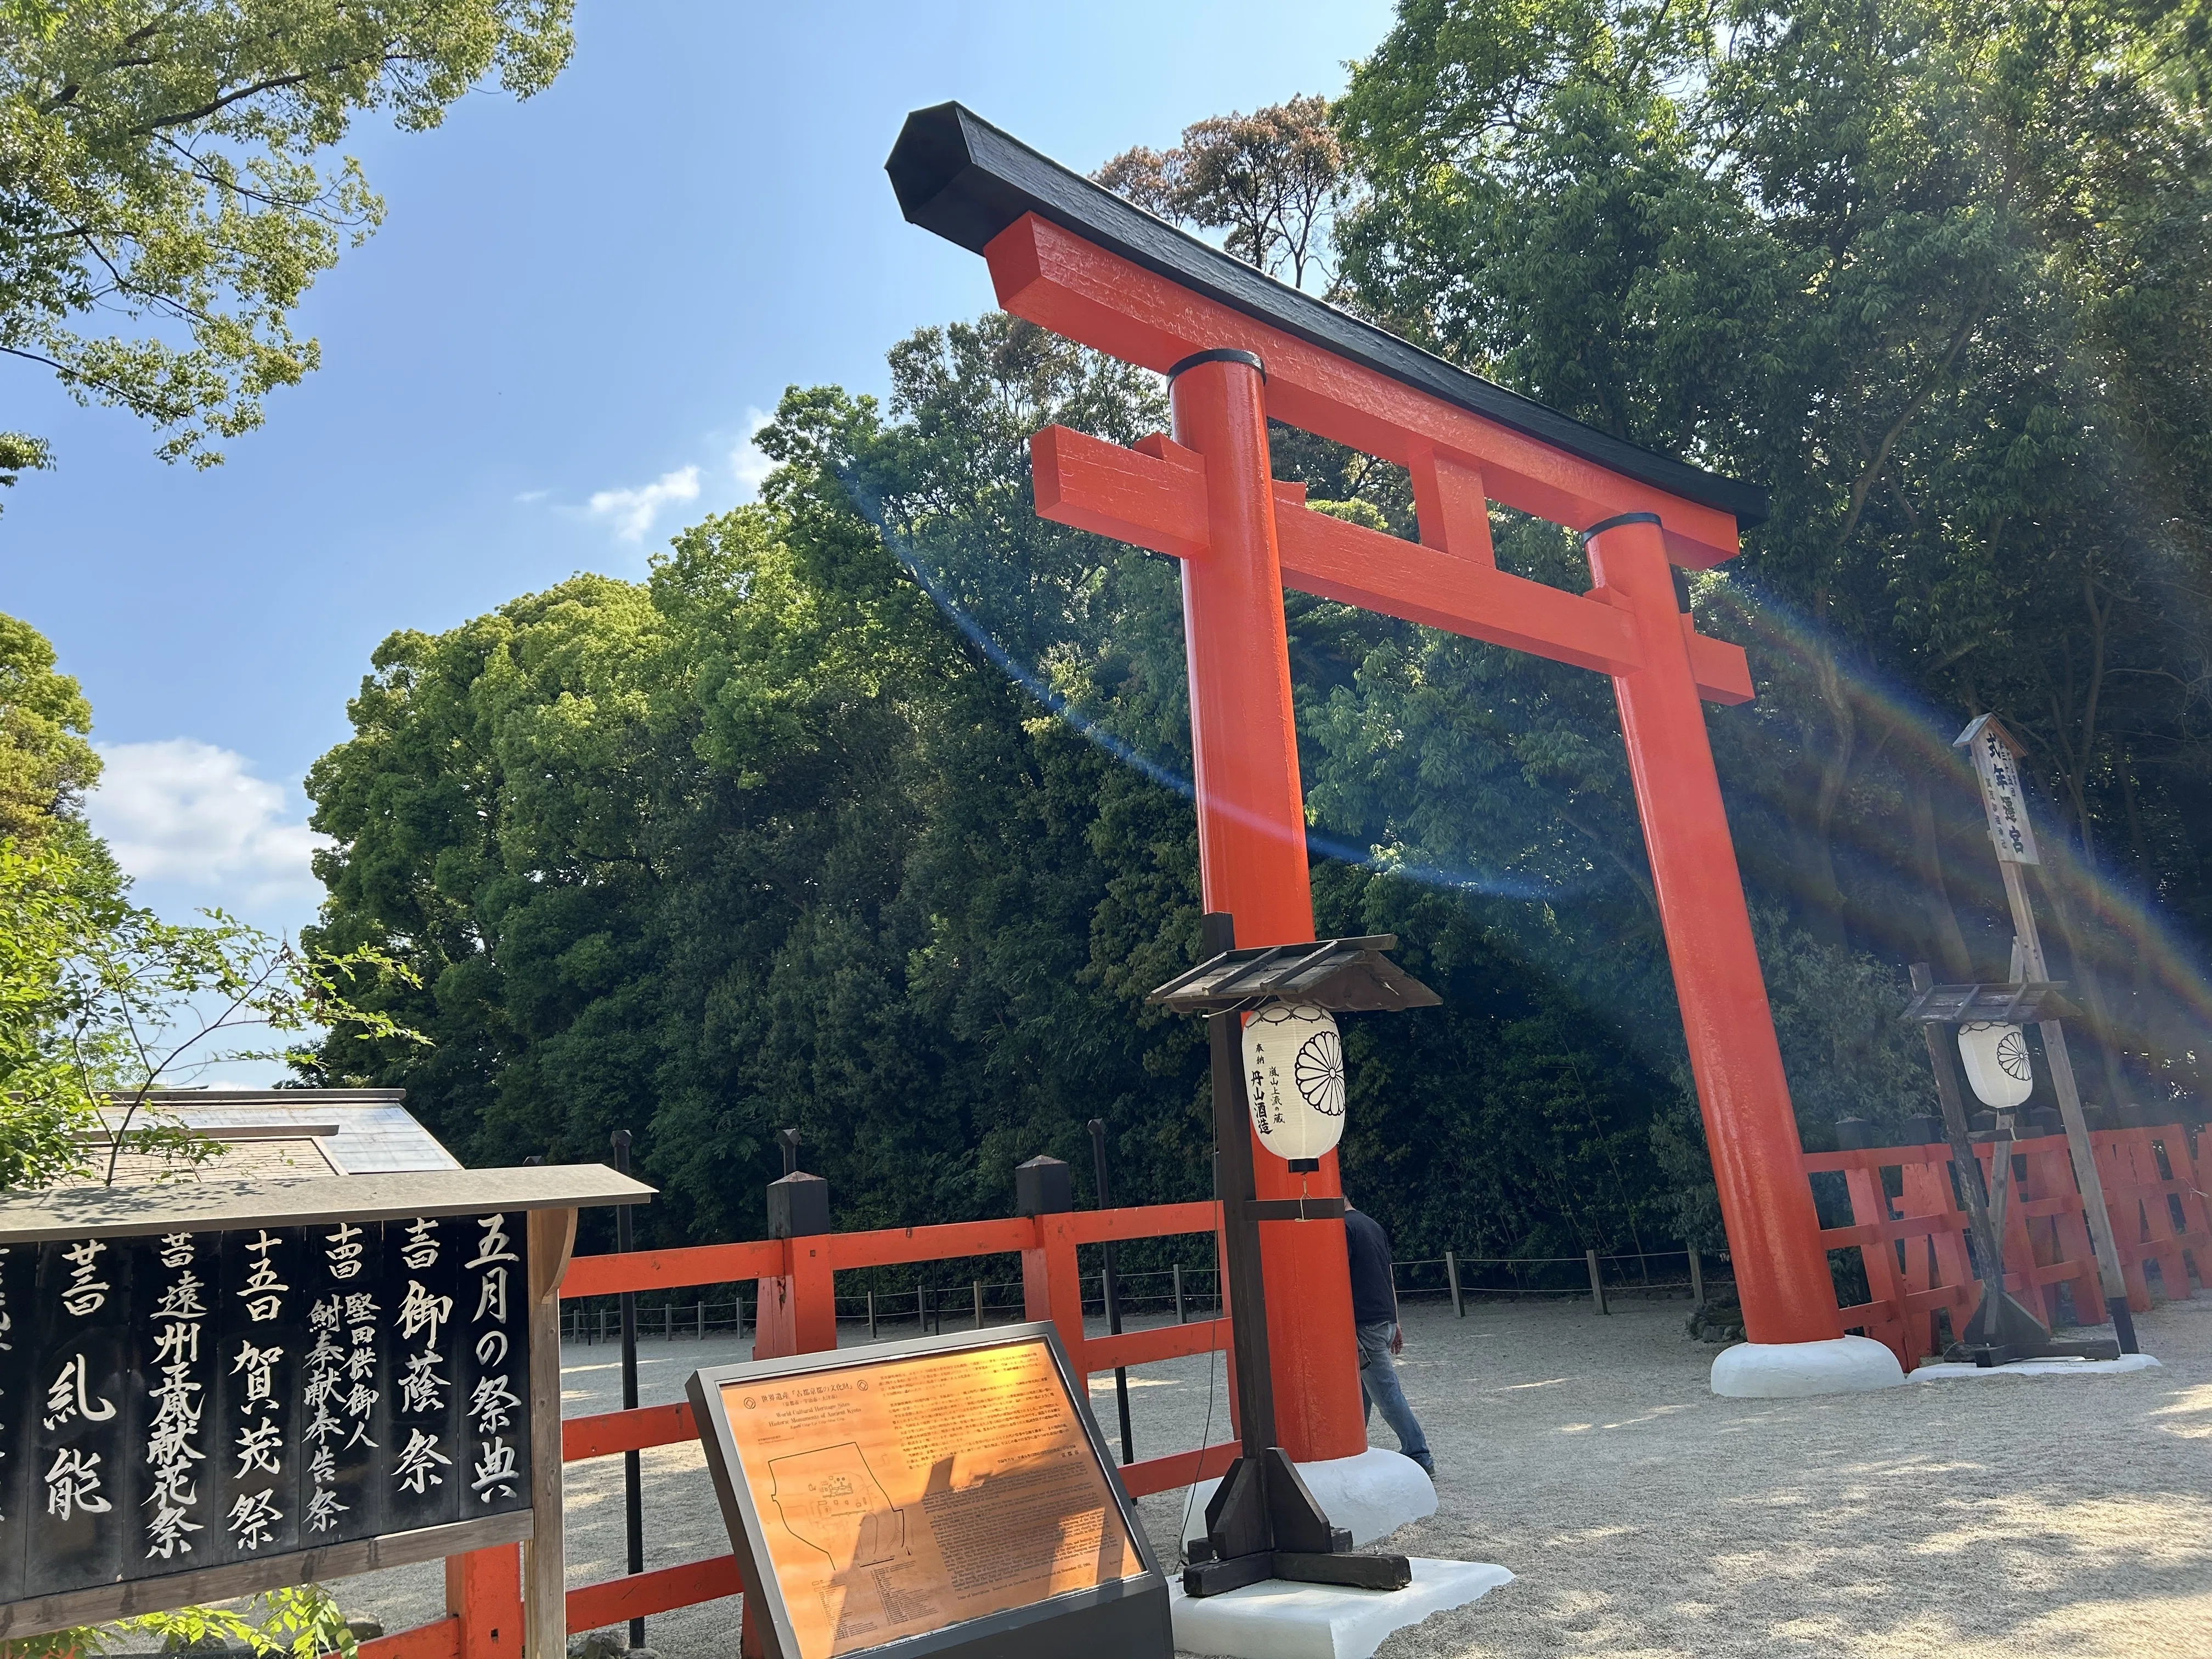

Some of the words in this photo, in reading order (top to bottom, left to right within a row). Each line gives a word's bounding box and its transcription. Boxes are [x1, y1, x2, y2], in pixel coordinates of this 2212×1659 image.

[1986, 732, 2024, 854] 式年遷宮
[1255, 1042, 1265, 1065] 奉納
[1250, 1070, 1273, 1135] 丹山酒造
[1268, 1066, 1285, 1124] 嵐山上流の蔵
[236, 1229, 290, 1322] 十五日
[391, 1280, 454, 1495] 御蔭祭
[465, 1213, 522, 1504] 五月の祭典
[226, 1339, 284, 1551] 賀茂祭
[790, 1414, 819, 1423] Monuments
[814, 1403, 837, 1412] Heritage
